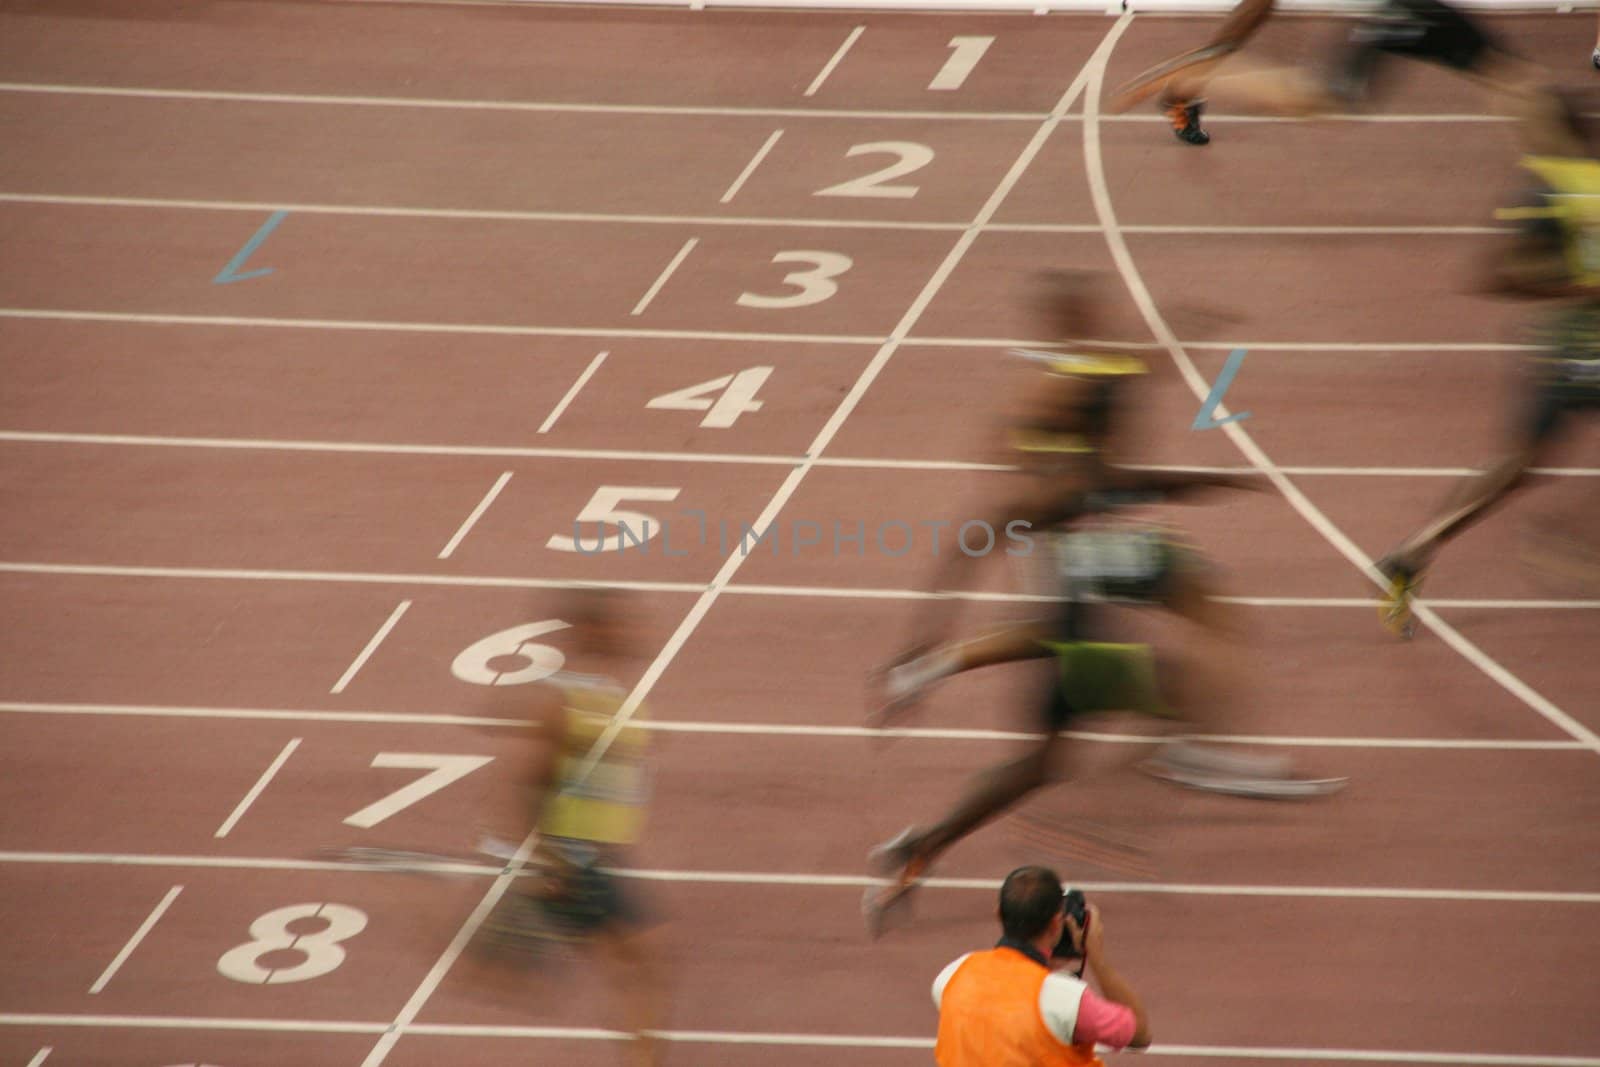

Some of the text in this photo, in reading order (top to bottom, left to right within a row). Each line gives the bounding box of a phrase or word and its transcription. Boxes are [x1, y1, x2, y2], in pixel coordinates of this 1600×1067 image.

[927, 36, 995, 90] 1
[813, 141, 935, 199] 2
[736, 251, 853, 309] 3
[646, 366, 774, 428] 4
[546, 485, 681, 553] 5
[451, 619, 570, 686] 6
[343, 752, 495, 828] 7
[217, 903, 368, 984] 8
